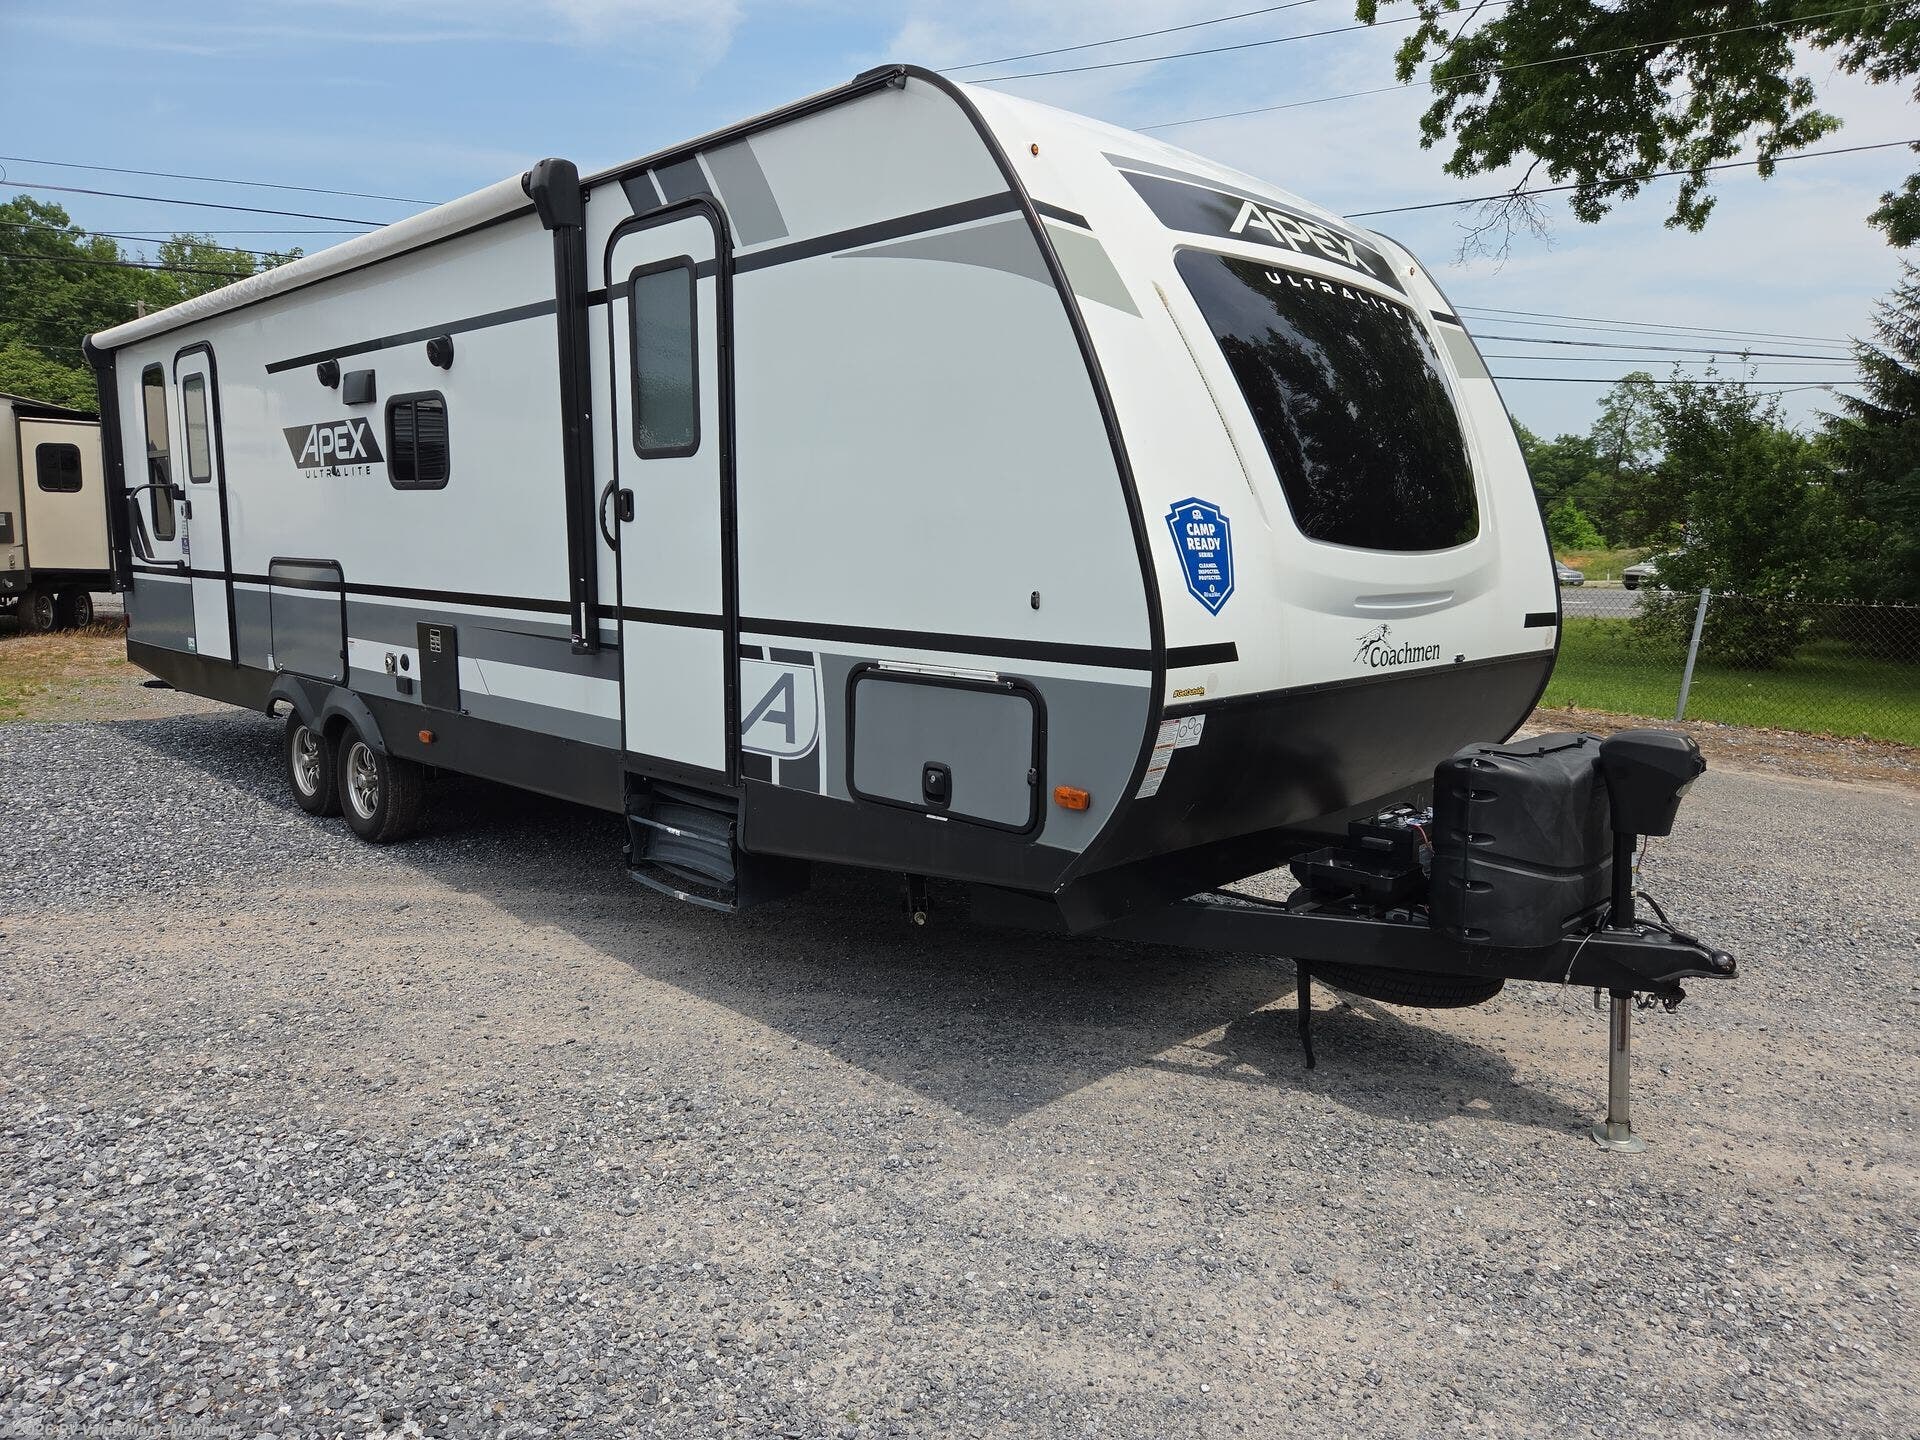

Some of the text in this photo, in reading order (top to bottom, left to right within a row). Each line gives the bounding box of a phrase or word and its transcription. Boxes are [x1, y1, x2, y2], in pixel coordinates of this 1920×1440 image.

[1229, 200, 1377, 276] APEX
[1265, 270, 1403, 320] ULTRALITE
[299, 419, 368, 467] APEX
[305, 465, 371, 479] ULTRALITE
[1186, 523, 1216, 536] CAMP
[1186, 537, 1221, 551] READY
[1370, 641, 1440, 668] Coachmen
[741, 672, 796, 745] A
